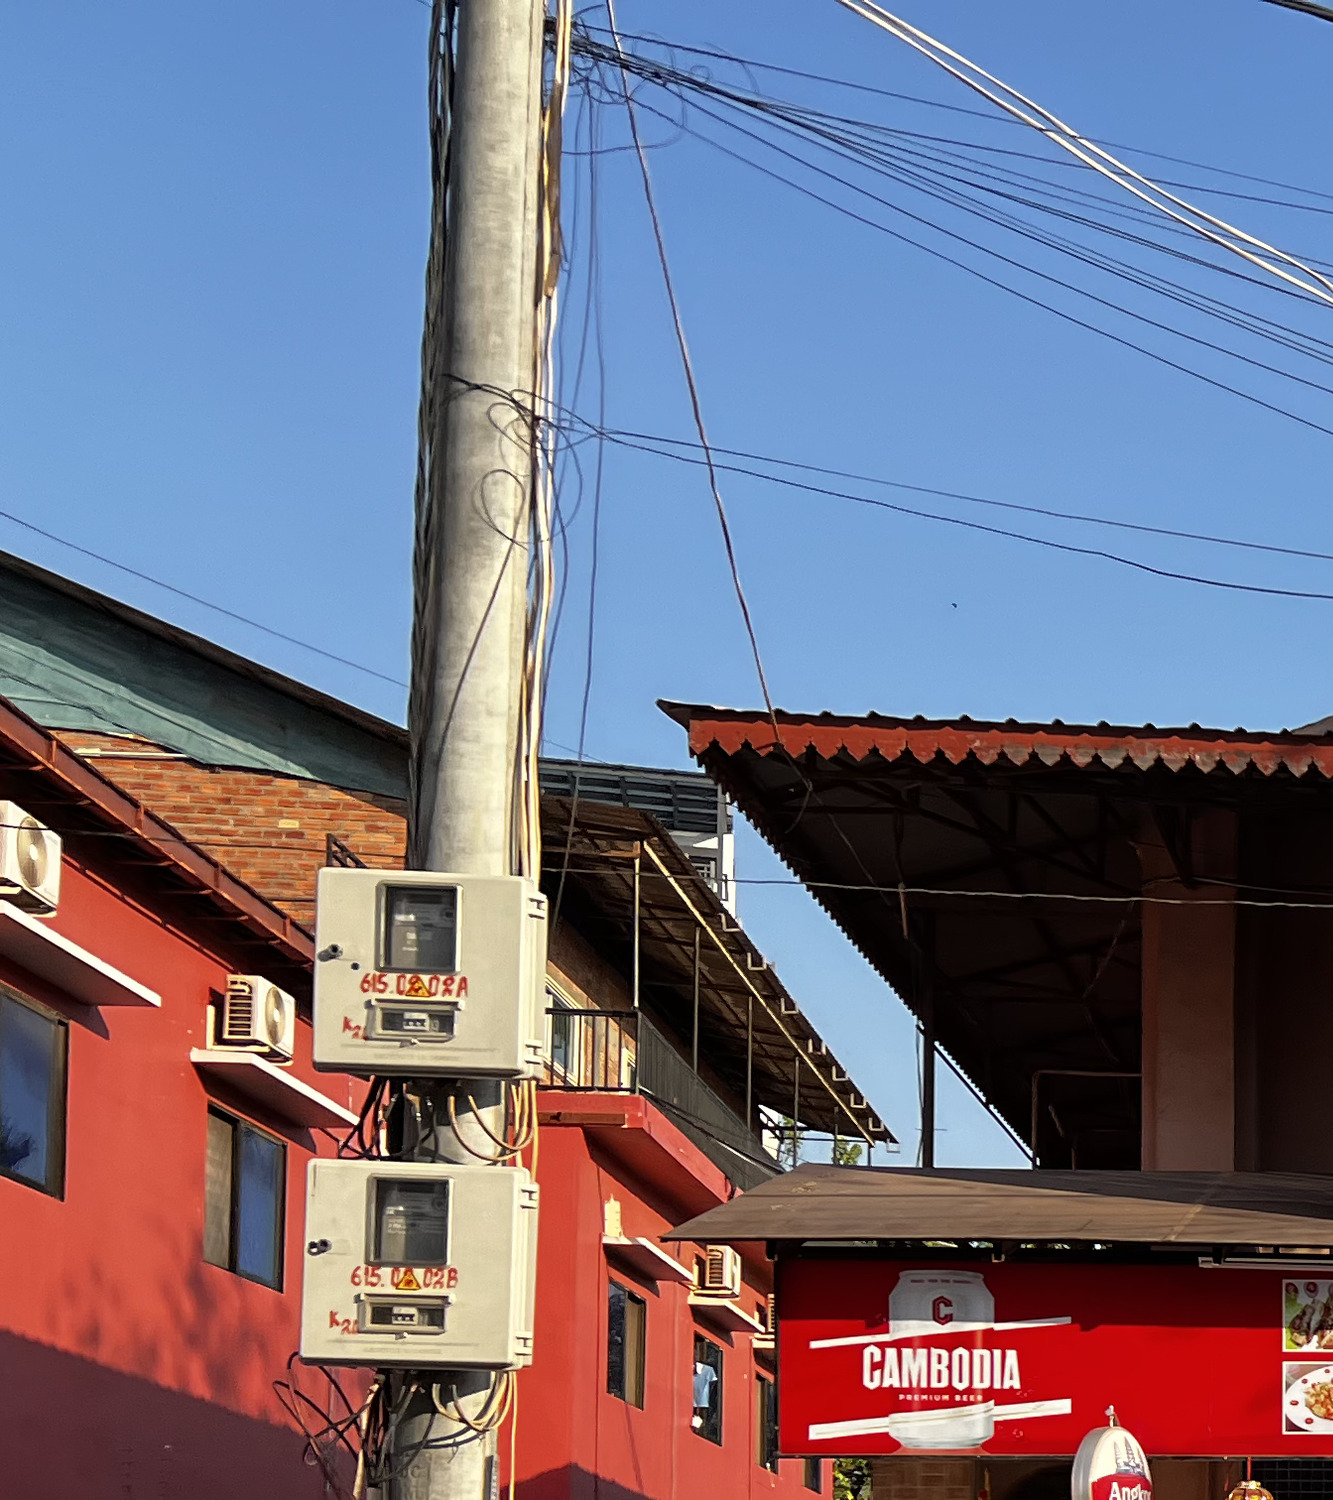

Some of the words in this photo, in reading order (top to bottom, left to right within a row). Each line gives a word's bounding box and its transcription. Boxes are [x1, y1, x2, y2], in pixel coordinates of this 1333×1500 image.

[932, 1295, 954, 1326] C
[862, 1344, 1022, 1391] CAMBODIA
[898, 1393, 950, 1401] PREMIUM
[954, 1393, 984, 1402] BEER
